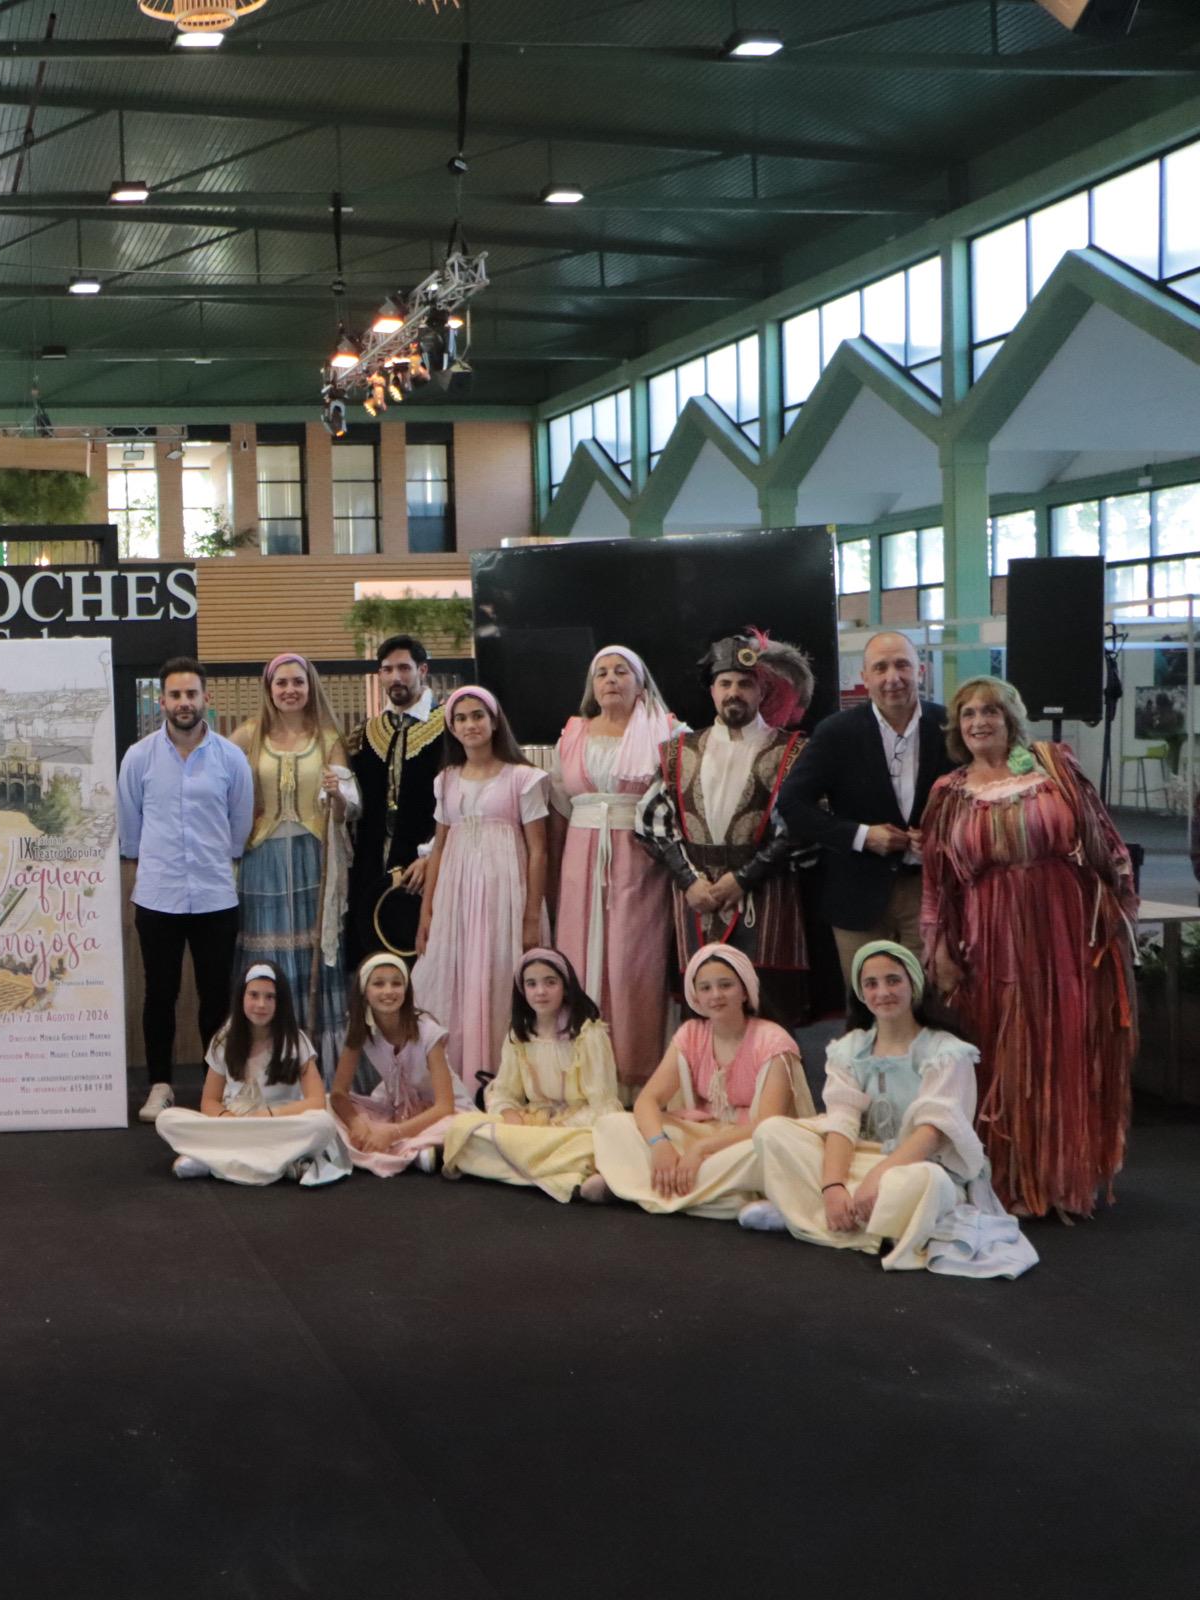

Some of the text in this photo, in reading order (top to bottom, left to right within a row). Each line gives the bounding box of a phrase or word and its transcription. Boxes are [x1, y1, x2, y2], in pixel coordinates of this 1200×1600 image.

[19, 837, 32, 859] IX
[34, 847, 101, 861] Teatro Popular
[26, 1012, 31, 1023] 2
[78, 1010, 82, 1021] /
[86, 1009, 109, 1021] 2026
